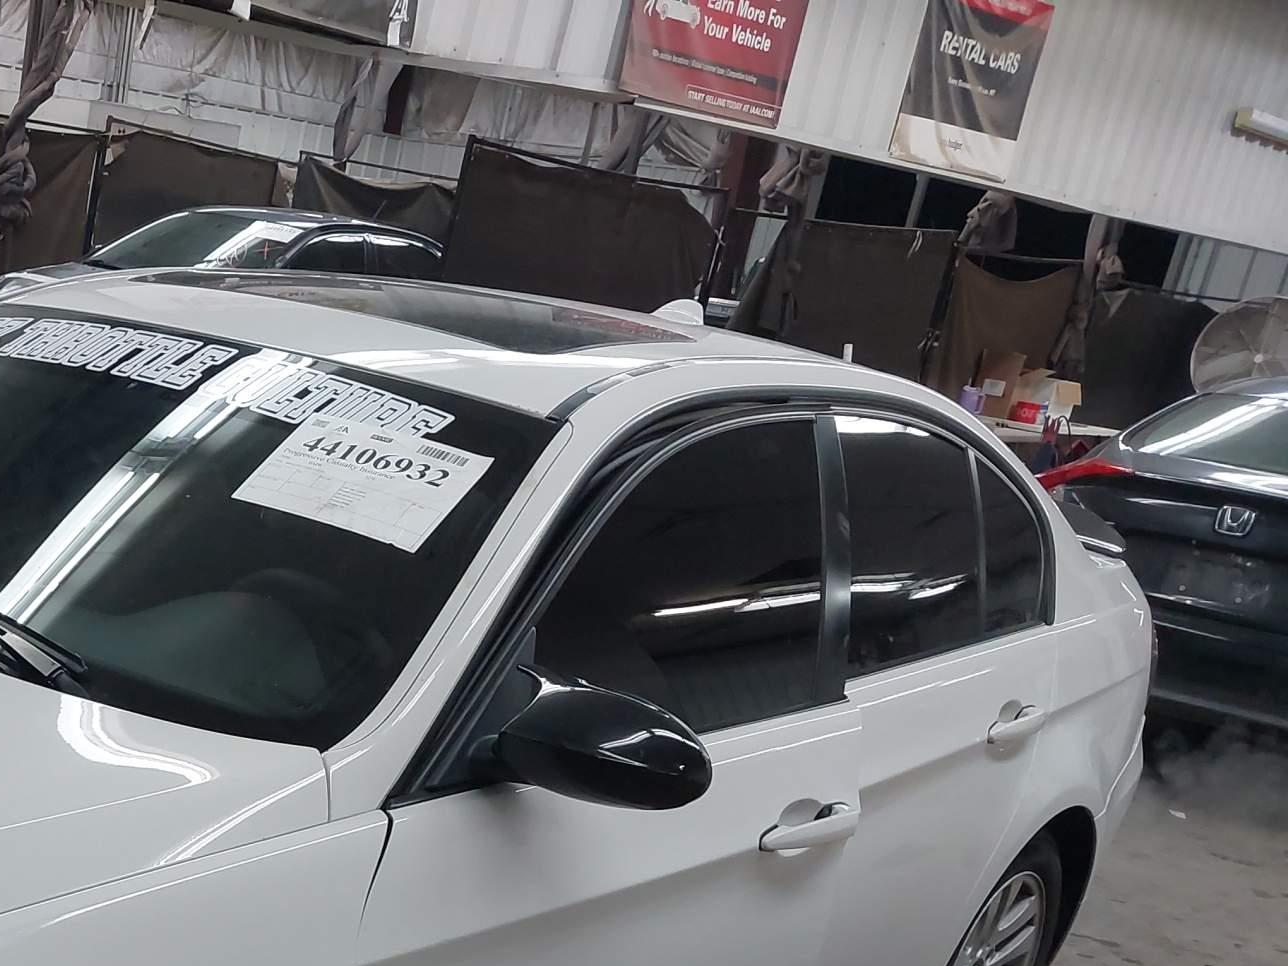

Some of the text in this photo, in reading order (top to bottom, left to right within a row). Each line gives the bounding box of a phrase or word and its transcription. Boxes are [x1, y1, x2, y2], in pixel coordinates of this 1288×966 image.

[703, 16, 771, 52] Your Vehicle
[707, 0, 786, 29] Earn More For
[939, 30, 1021, 74] RENTAL CARS
[303, 437, 450, 488] 44106932
